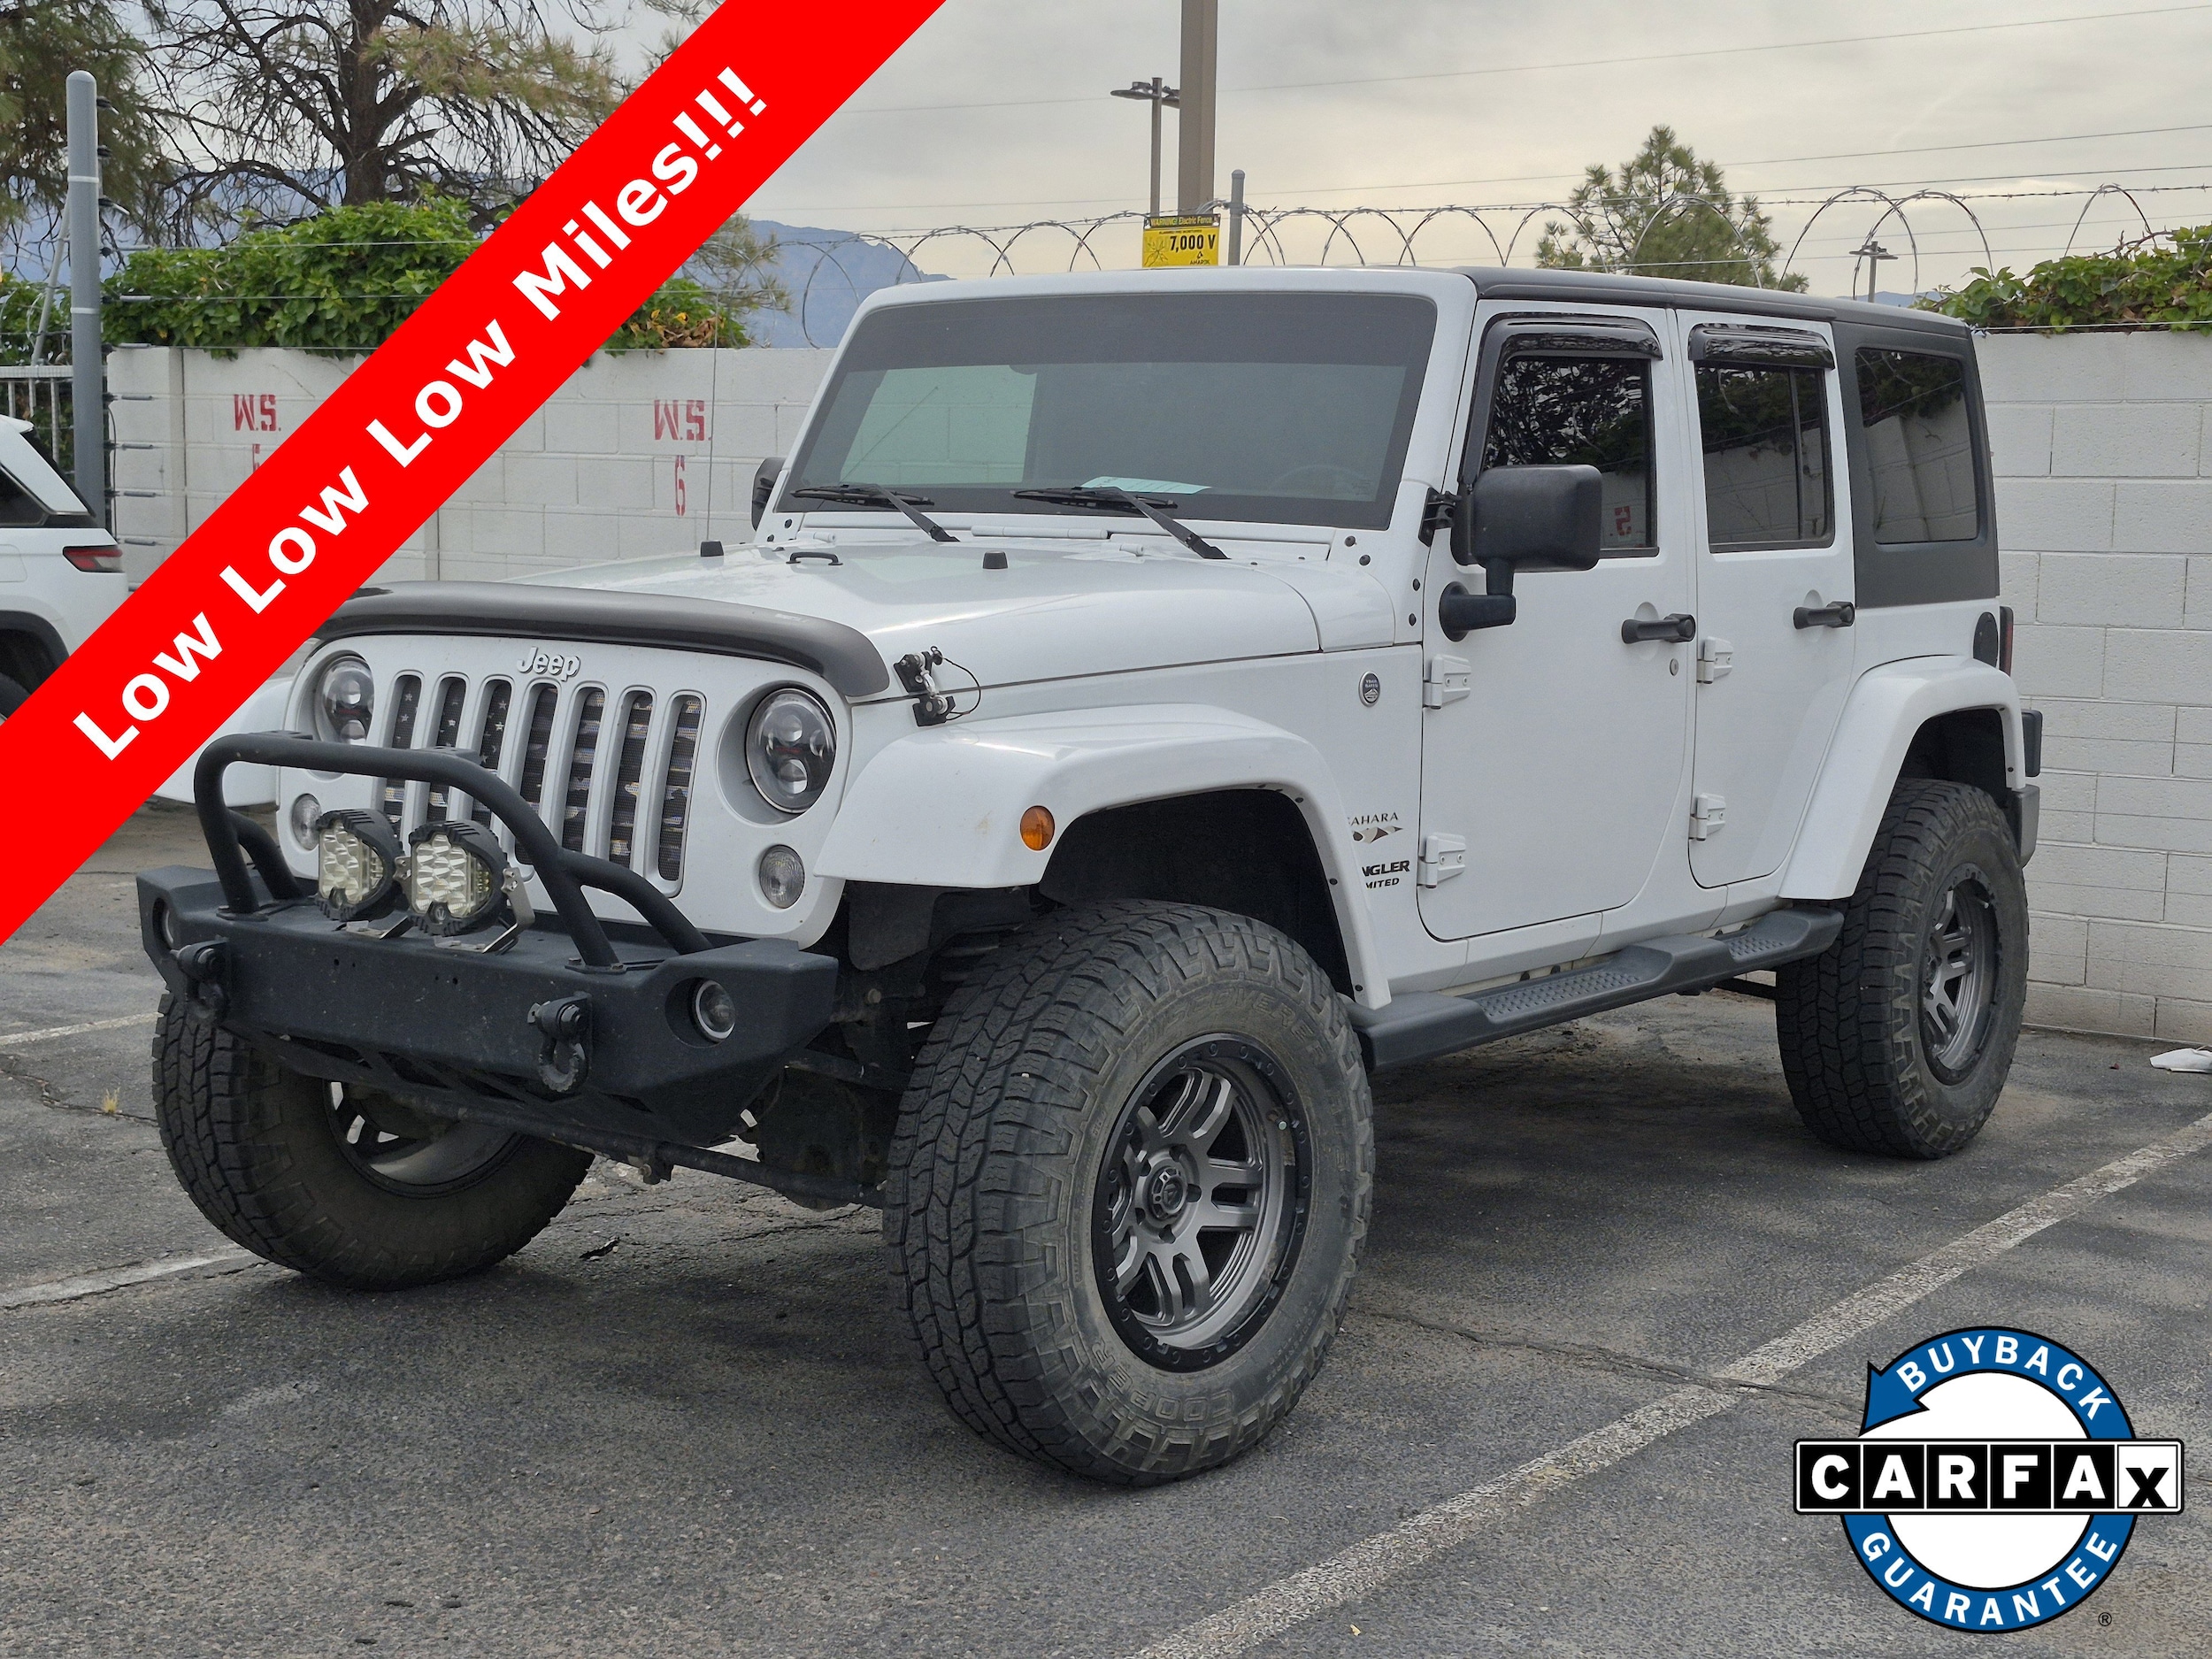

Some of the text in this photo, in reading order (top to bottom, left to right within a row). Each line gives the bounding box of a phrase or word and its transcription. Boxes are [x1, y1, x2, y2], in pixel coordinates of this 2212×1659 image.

[1170, 234, 1216, 253] 7,000 V
[517, 646, 581, 682] Jeep
[1348, 811, 1399, 826] AHARA
